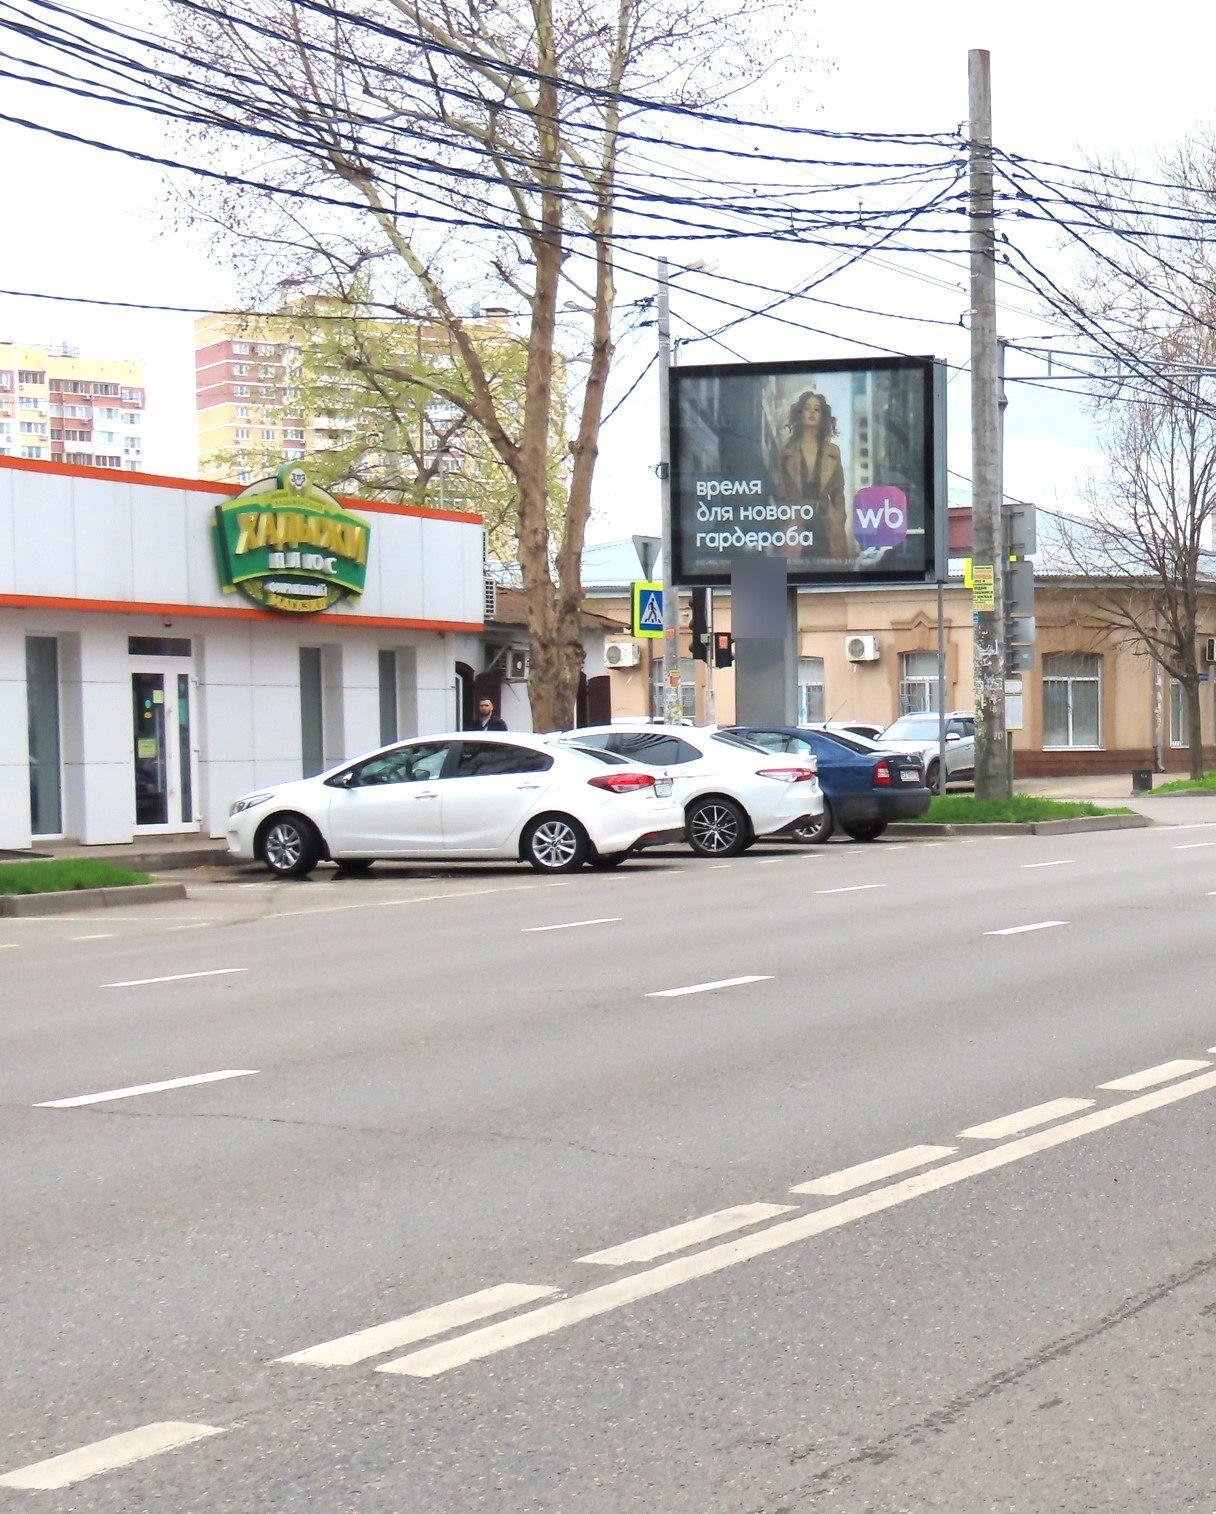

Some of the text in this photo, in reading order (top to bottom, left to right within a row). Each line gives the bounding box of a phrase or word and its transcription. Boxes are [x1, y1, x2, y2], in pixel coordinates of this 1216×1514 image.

[696, 479, 762, 500] время
[696, 501, 814, 522] для нового
[856, 498, 904, 529] wb
[696, 525, 814, 551] гардероба
[268, 552, 337, 575] ПЛЮС
